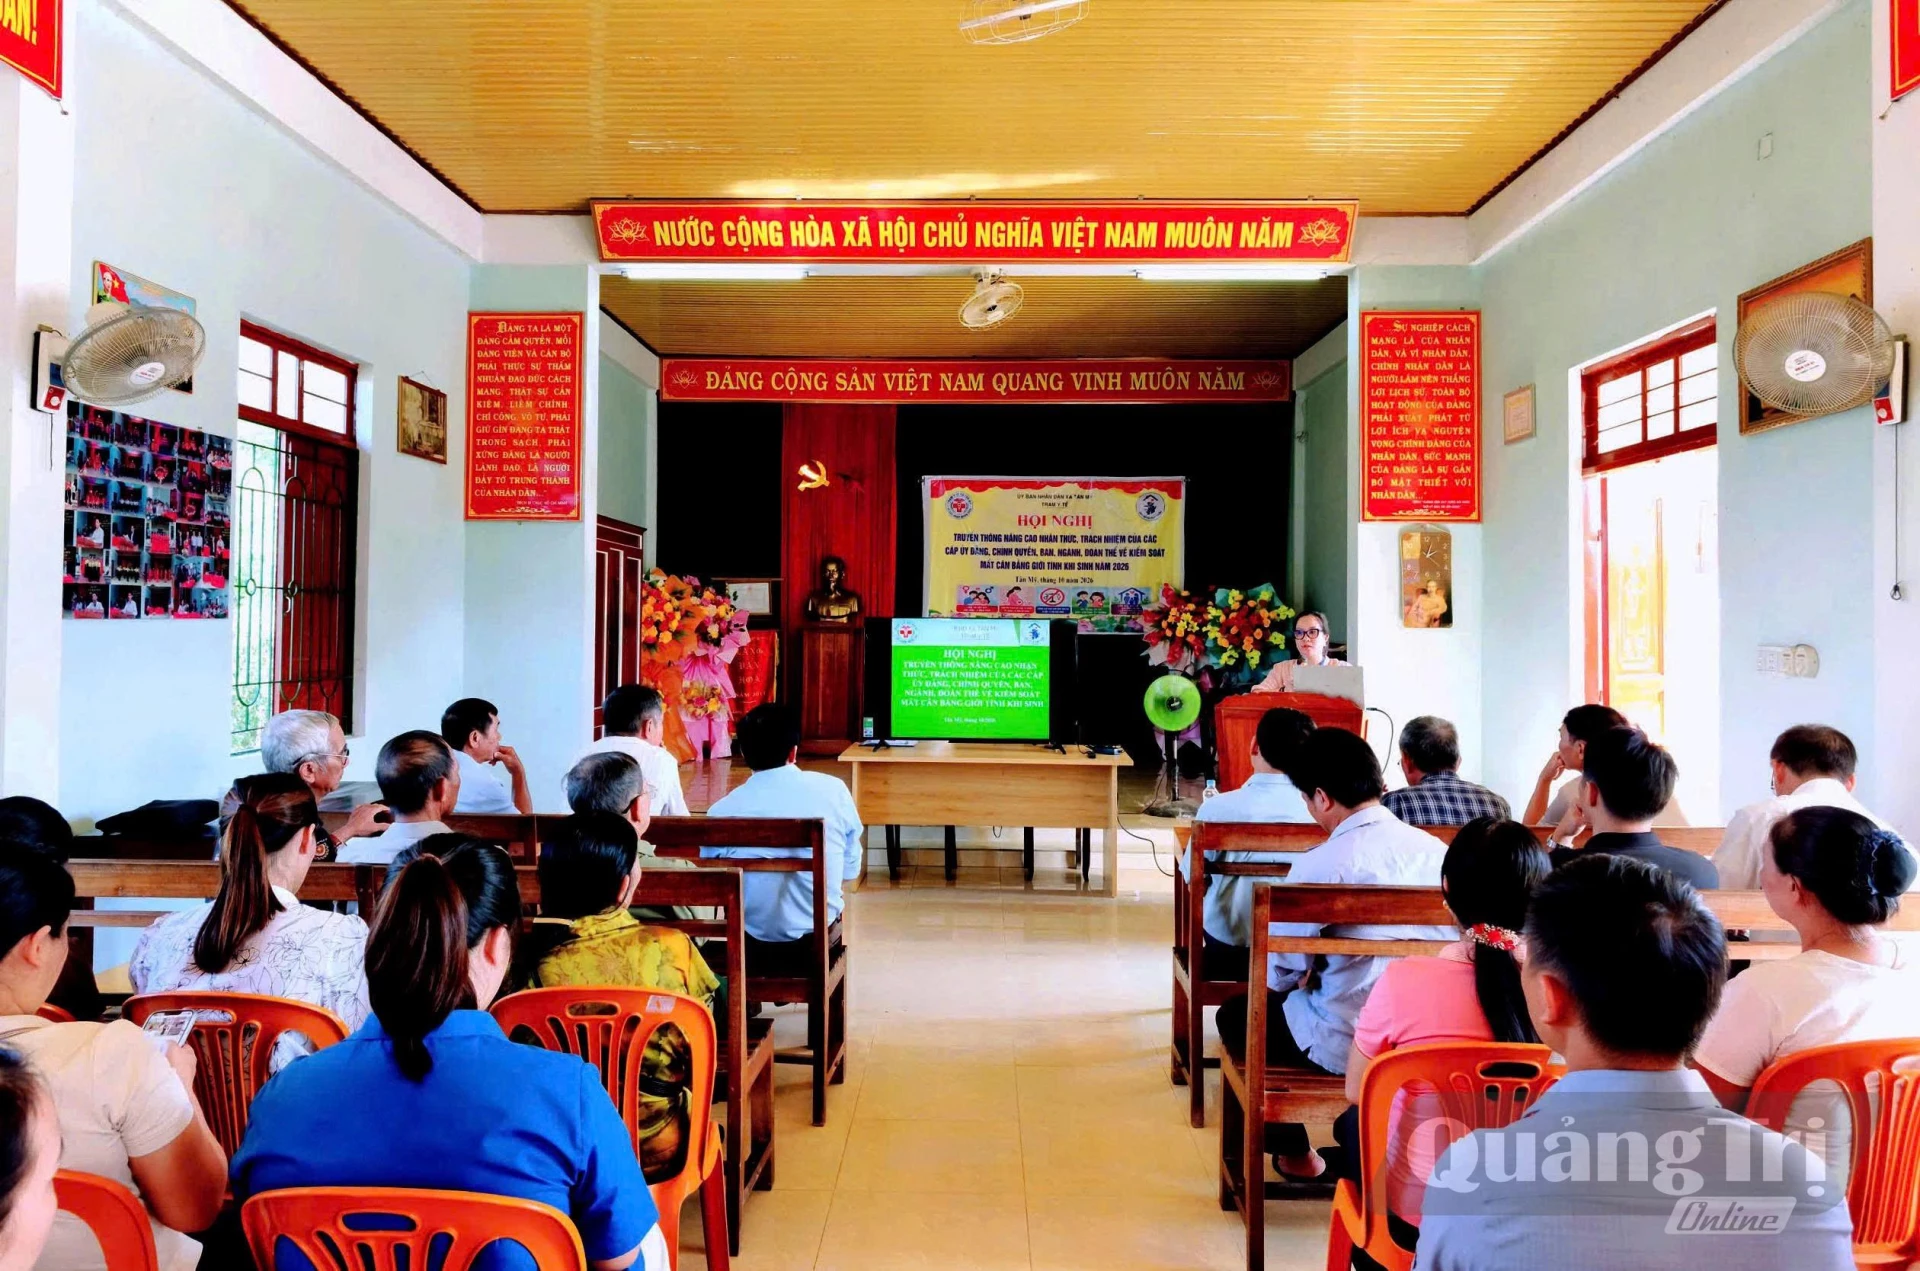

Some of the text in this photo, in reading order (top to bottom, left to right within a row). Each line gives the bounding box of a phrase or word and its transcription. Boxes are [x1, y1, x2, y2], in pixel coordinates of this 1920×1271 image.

[653, 213, 1294, 252] NƯỚC CỘNG HÒA XÃ HỘI CHỦ NGHĨA VIỆT NAM MUÔN NĂM
[706, 366, 1245, 395] ĐẢNG CỘNG SẢN VIỆT NAM QUANG VINH MUÔN NĂM
[1052, 515, 1092, 529] NGHỊ
[1025, 534, 1037, 542] CAO
[968, 650, 996, 660] NGHỊ
